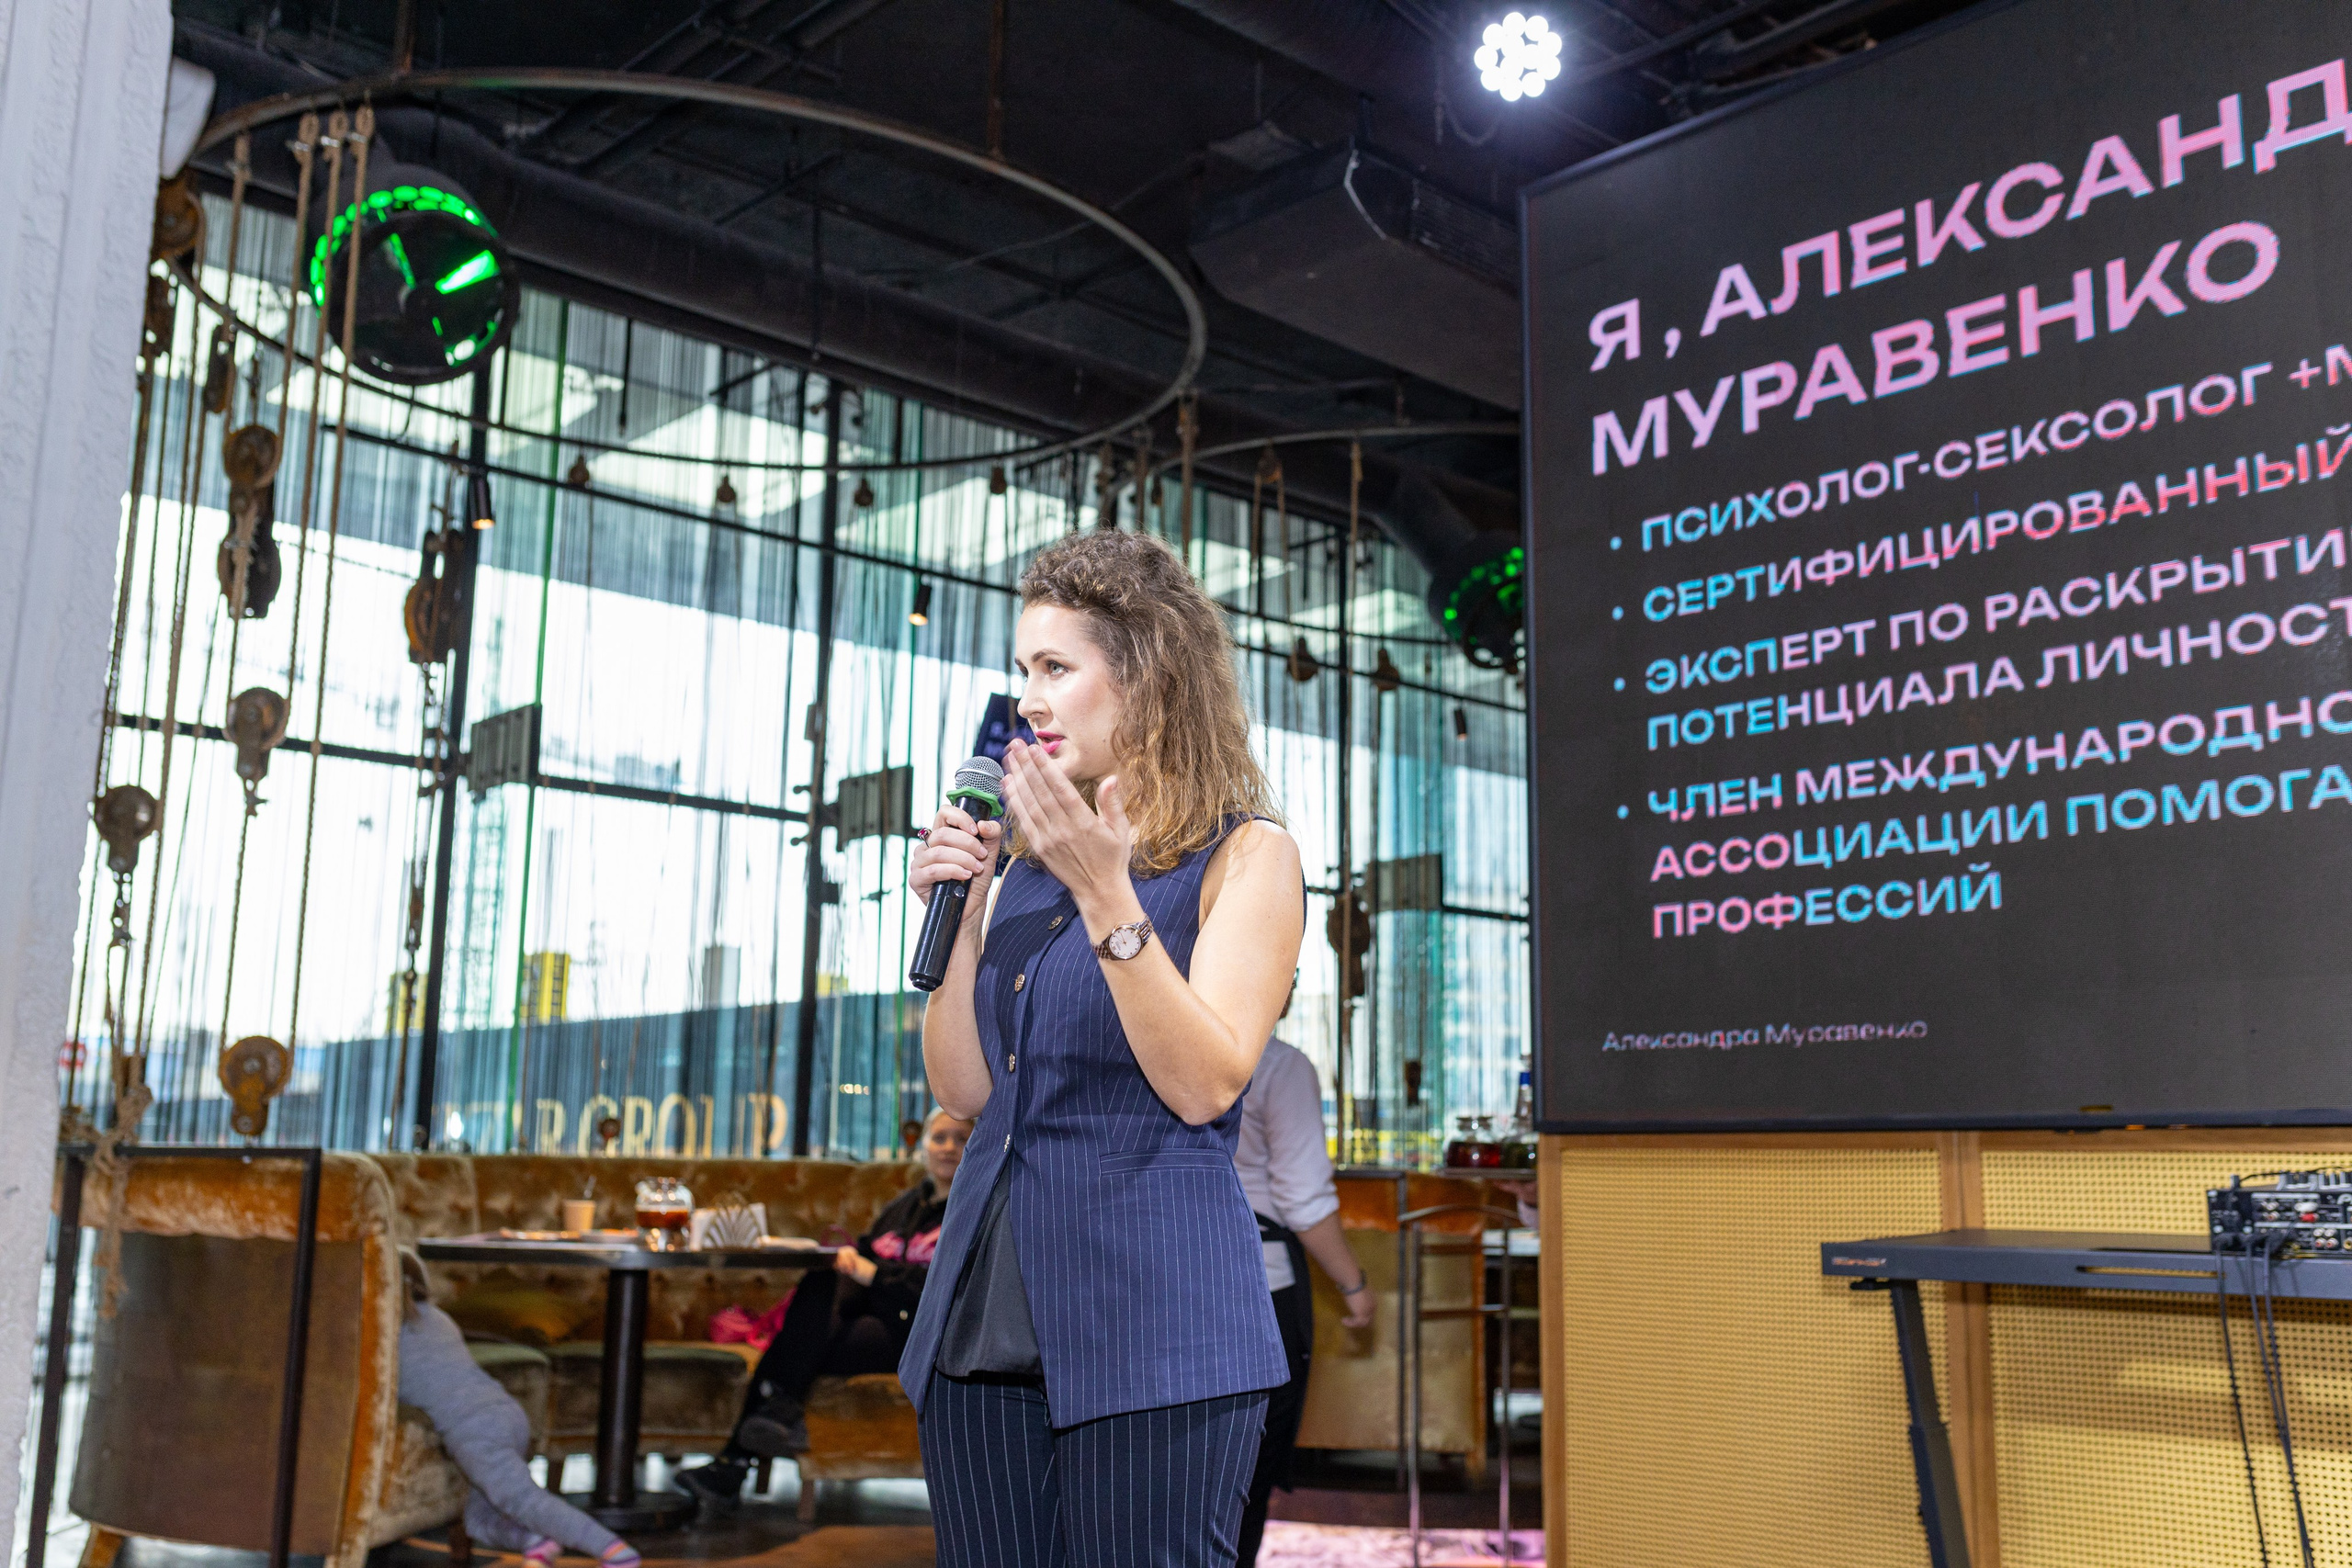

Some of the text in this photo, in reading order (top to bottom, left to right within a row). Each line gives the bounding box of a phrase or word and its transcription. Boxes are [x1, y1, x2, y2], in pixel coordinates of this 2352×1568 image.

[1700, 58, 2352, 336] АЛЕКСАНД
[1592, 220, 2280, 476] МУРАВЕНКО
[1642, 362, 2273, 552] ПСИХОЛОГ-СЕКСОЛОГ
[1643, 423, 2352, 622] СЕРТИФИЦИРОВАННЫЙ
[1645, 527, 2352, 694] ЭКСПЕРТ ПО РАСКРЫТИ
[1647, 656, 2025, 750] ПОТЕНЦИАЛА
[1648, 773, 1782, 821] ЧЛЕН
[1651, 763, 2352, 882] АССОЦИАЦИИ ПОМОГА
[1654, 862, 2002, 938] ПРОФЕССИЙ
